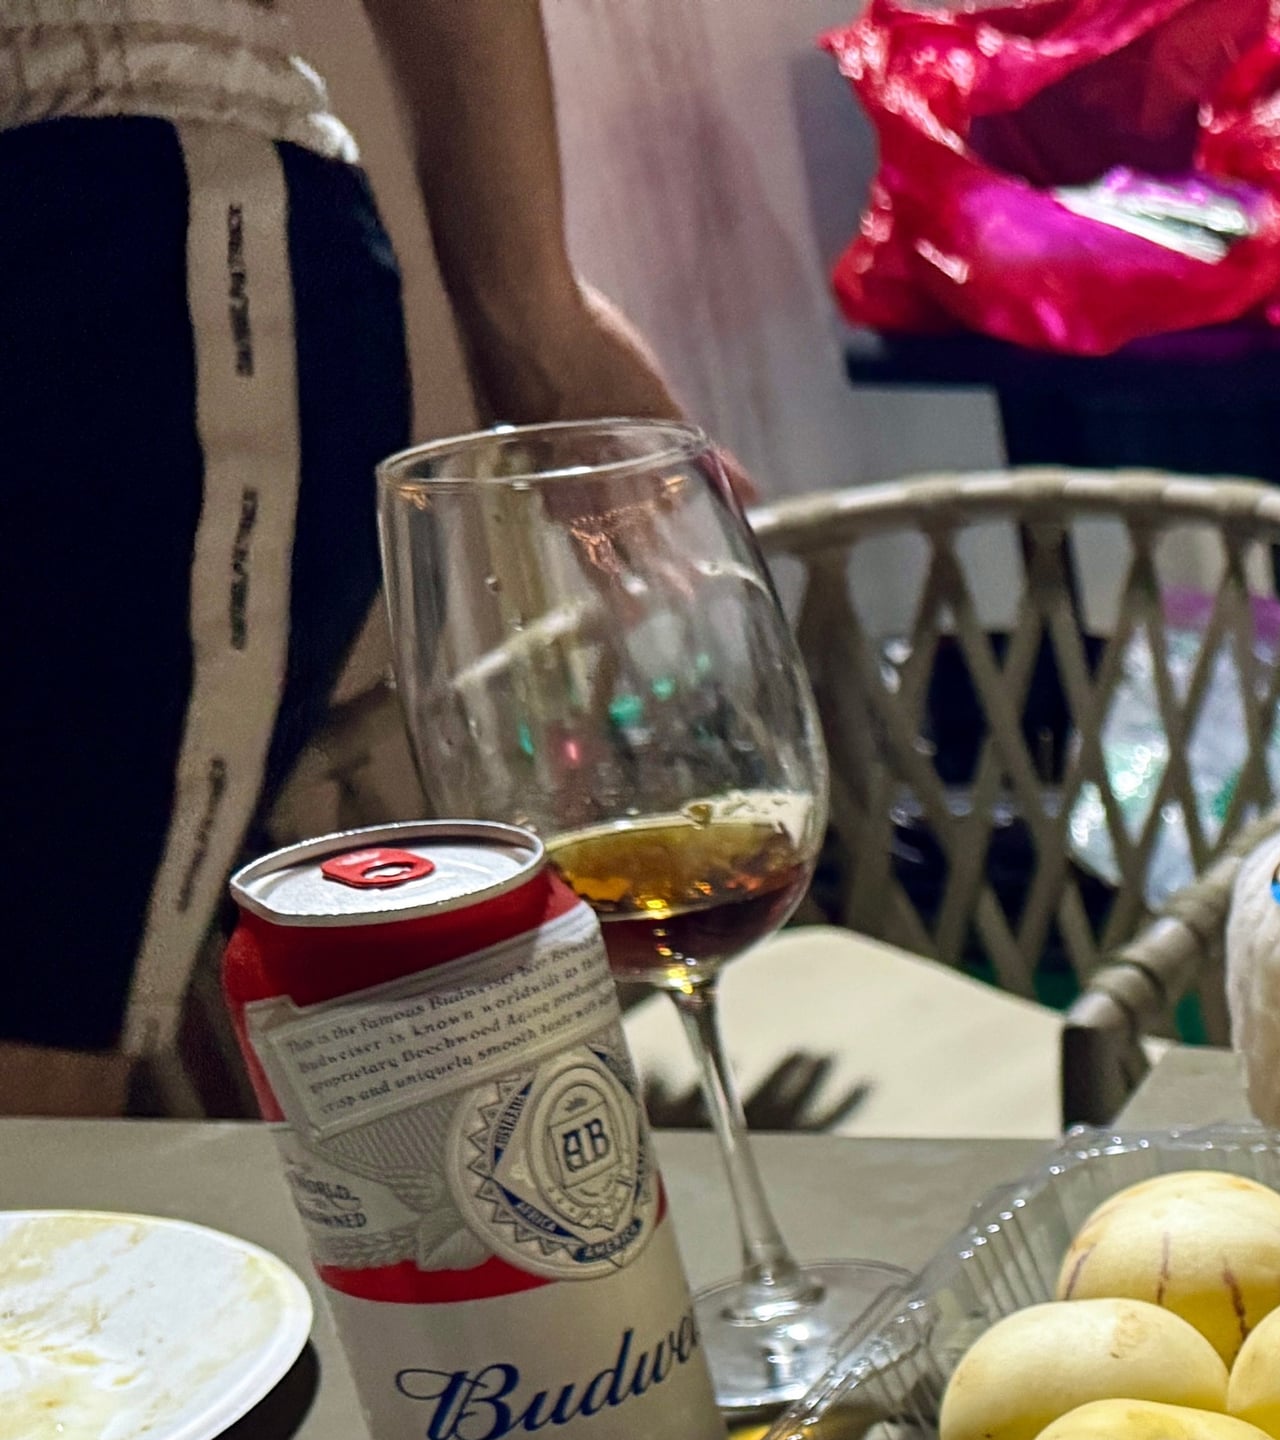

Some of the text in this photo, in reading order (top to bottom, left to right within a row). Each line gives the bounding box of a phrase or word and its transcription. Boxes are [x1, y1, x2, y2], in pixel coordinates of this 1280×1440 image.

[360, 1005, 425, 1033] famous
[411, 1008, 474, 1038] known
[310, 1056, 399, 1096] proprietary
[401, 1017, 501, 1064] Beechwood
[359, 1080, 392, 1102] and
[394, 1054, 474, 1089] uniquely
[477, 1026, 538, 1061] smooth
[563, 1118, 610, 1173] AB
